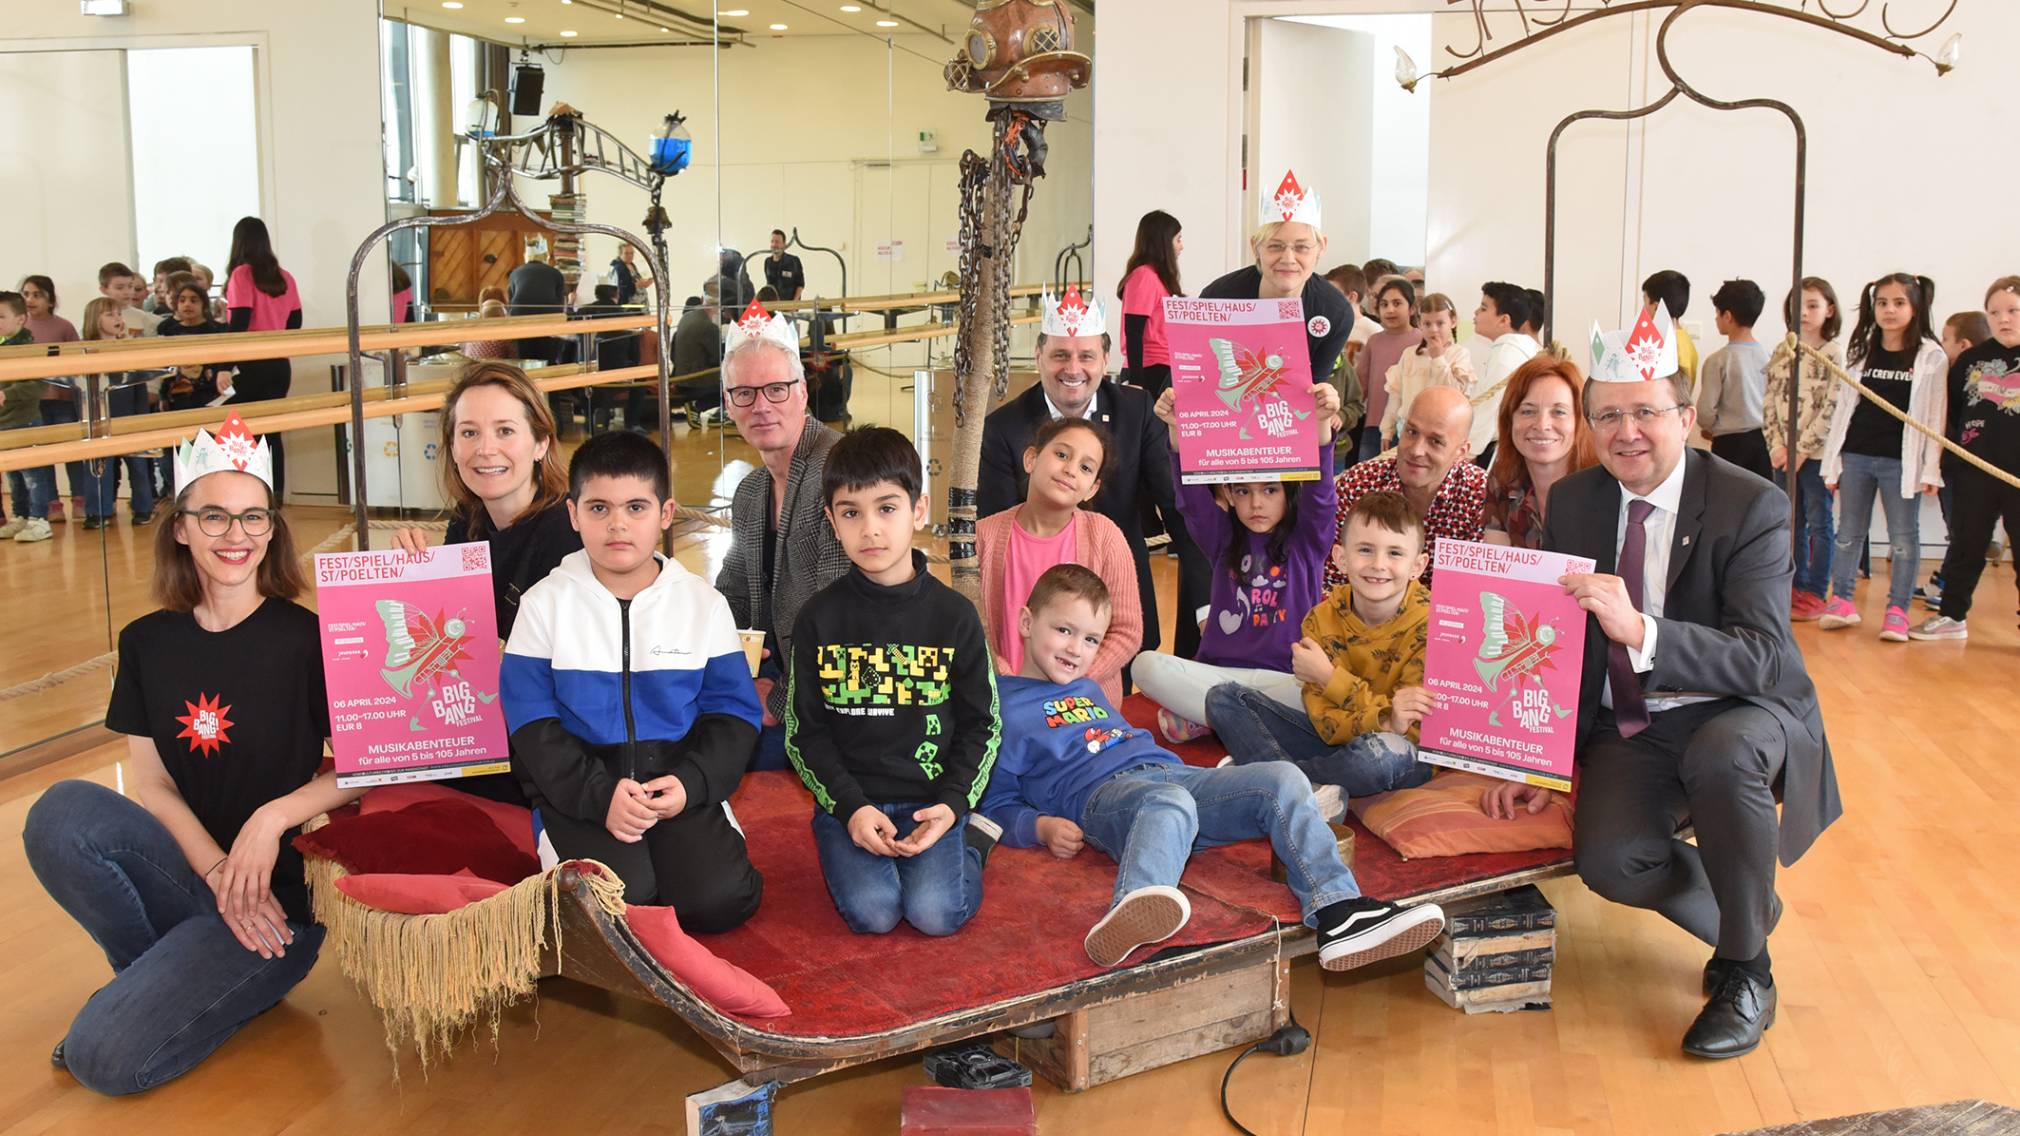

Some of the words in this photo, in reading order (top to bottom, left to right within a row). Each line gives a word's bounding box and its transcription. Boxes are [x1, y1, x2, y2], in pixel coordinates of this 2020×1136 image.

[1166, 300, 1257, 313] FEST/SPIEL/HAUS/
[1168, 310, 1232, 322] ST/POELTEN/
[1872, 368, 1895, 380] CREW
[1265, 400, 1289, 418] BIG
[1221, 420, 1237, 428] UHR
[1257, 411, 1293, 437] BANG
[1181, 430, 1196, 438] EUR
[1206, 446, 1292, 458] MUSIKABENTEUER
[1198, 458, 1210, 466] für
[1210, 458, 1224, 466] alle
[1247, 457, 1259, 465] bis
[1260, 456, 1274, 464] 105
[1275, 455, 1301, 464] Jahren
[319, 551, 436, 570] FEST/SPIEL/HAUS/
[1438, 542, 1543, 566] FEST/SPIEL/HAUS/
[1438, 555, 1512, 575] ST/POELTEN/
[321, 566, 405, 582] ST/POELTEN/
[442, 681, 471, 704] BIG
[1427, 678, 1439, 686] 06
[1439, 680, 1462, 690] APRIL
[1463, 683, 1483, 694] 2024
[333, 700, 347, 709] 06
[347, 698, 374, 708] APRIL
[374, 696, 397, 706] 2024
[1043, 696, 1095, 716] SUPER
[1471, 699, 1489, 710] UHR
[1523, 689, 1550, 708] BIG
[199, 709, 216, 725] BIG
[386, 709, 407, 719] UHR
[432, 696, 476, 725] BANG
[1045, 706, 1109, 728] MARIO
[1512, 700, 1551, 728] BANG
[336, 723, 355, 732] EUR
[356, 722, 363, 731] 8
[455, 716, 483, 728] FESTIVAL
[1529, 726, 1555, 734] FESTIVAL
[368, 736, 476, 755] MUSIKABENTEUER
[1450, 728, 1544, 755] MUSIKABENTEUER
[358, 756, 372, 766] für
[374, 755, 390, 765] alle
[393, 754, 410, 763] von
[412, 752, 419, 761] 5
[420, 751, 434, 760] bis
[435, 749, 454, 759] 105
[455, 747, 487, 758] Jahren
[1439, 737, 1452, 746] für
[1452, 739, 1467, 750] alle
[1468, 744, 1484, 753] von
[1485, 745, 1491, 754] 5
[1492, 747, 1505, 757] bis
[1506, 749, 1521, 760] 105
[1522, 754, 1552, 767] Jahren
